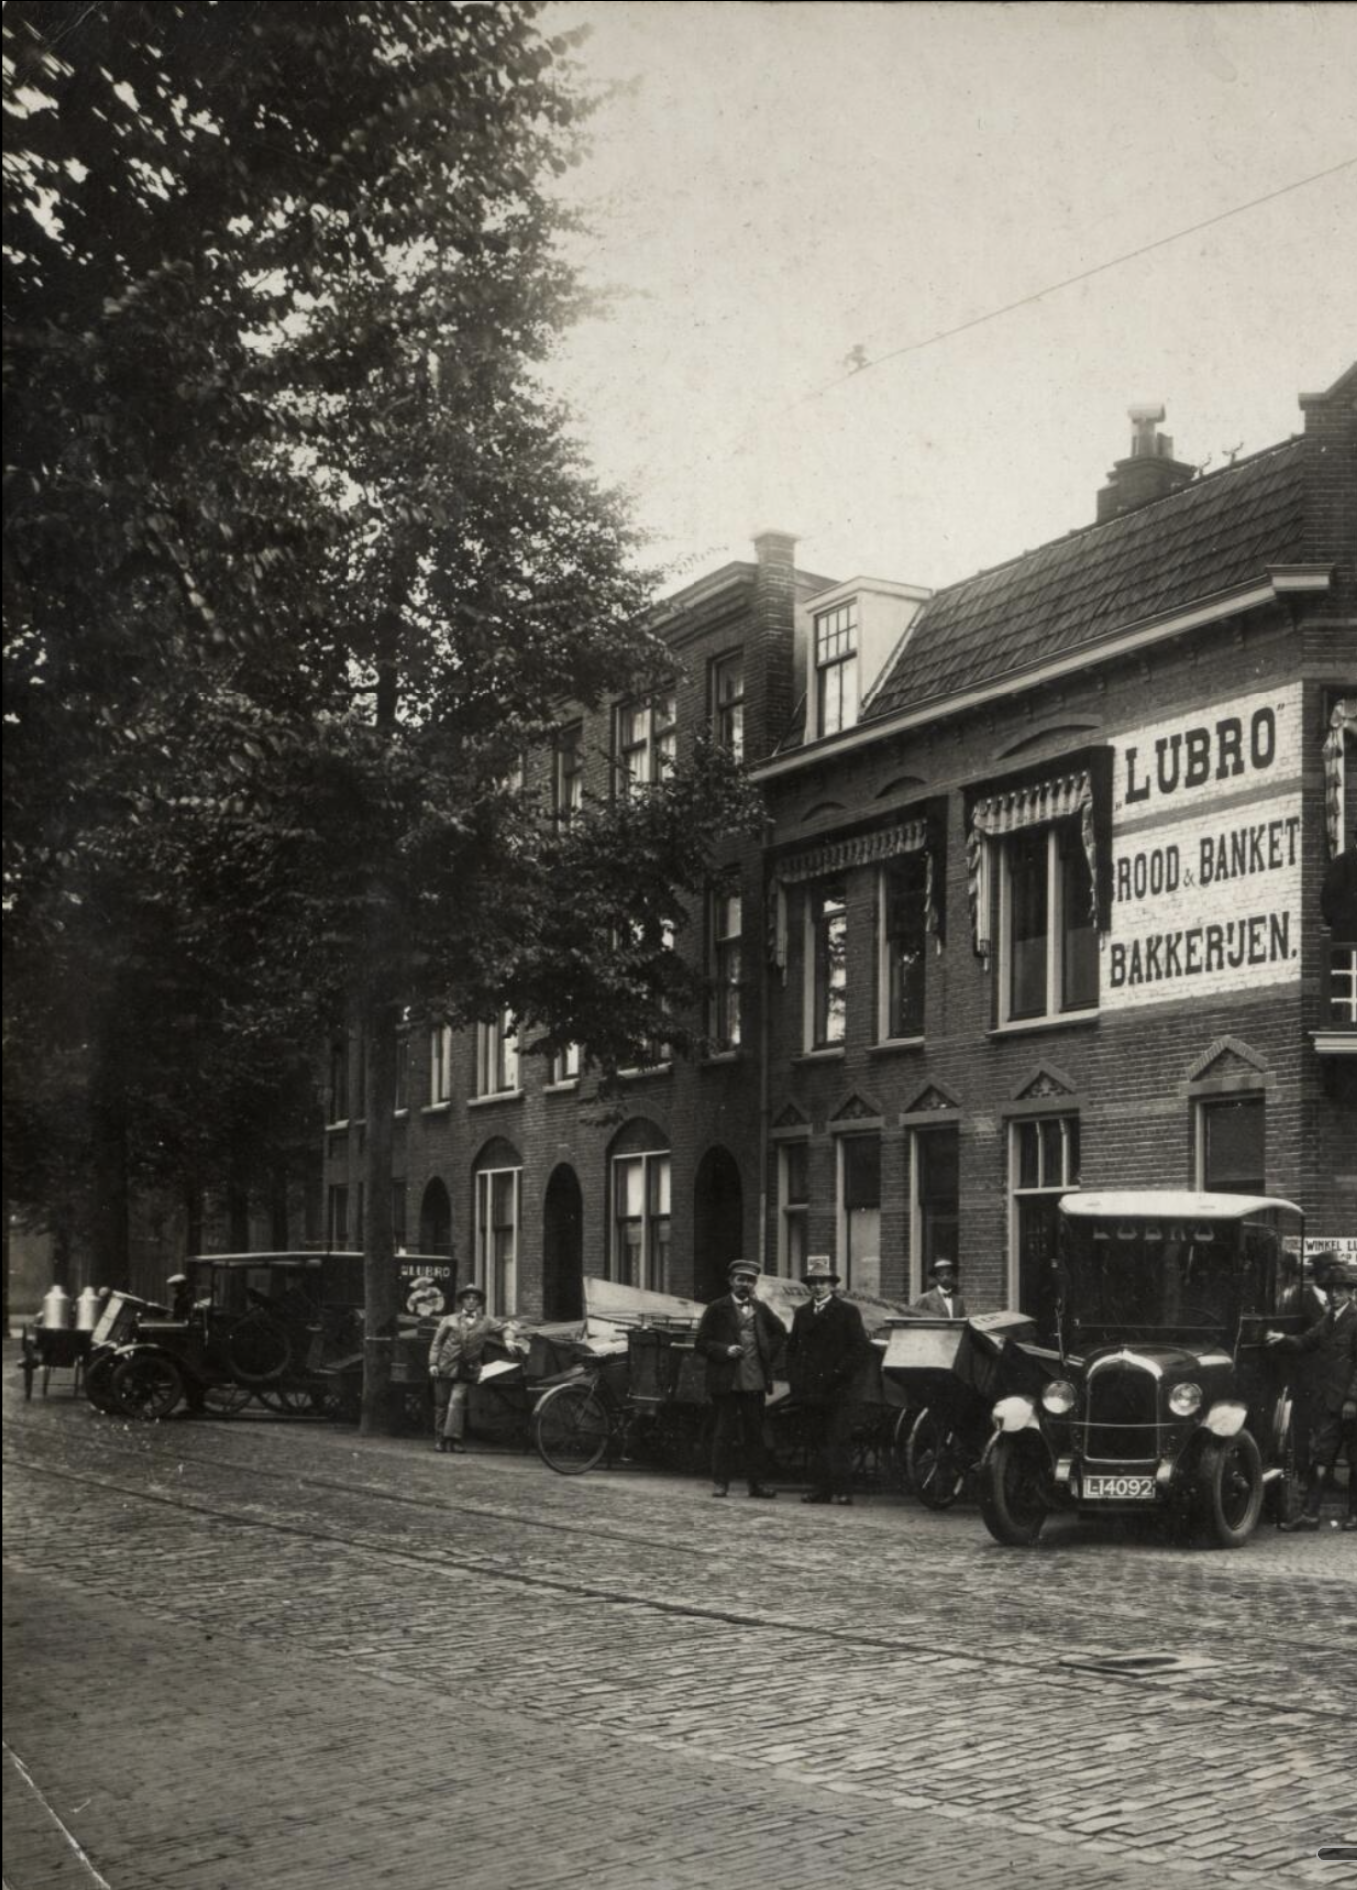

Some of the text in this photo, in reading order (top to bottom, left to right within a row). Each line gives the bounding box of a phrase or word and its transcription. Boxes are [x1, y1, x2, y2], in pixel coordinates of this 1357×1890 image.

[1113, 816, 1300, 902] ROOD & BANKET
[1304, 1240, 1343, 1252] WINKEL
[1086, 1479, 1153, 1496] L-14092
